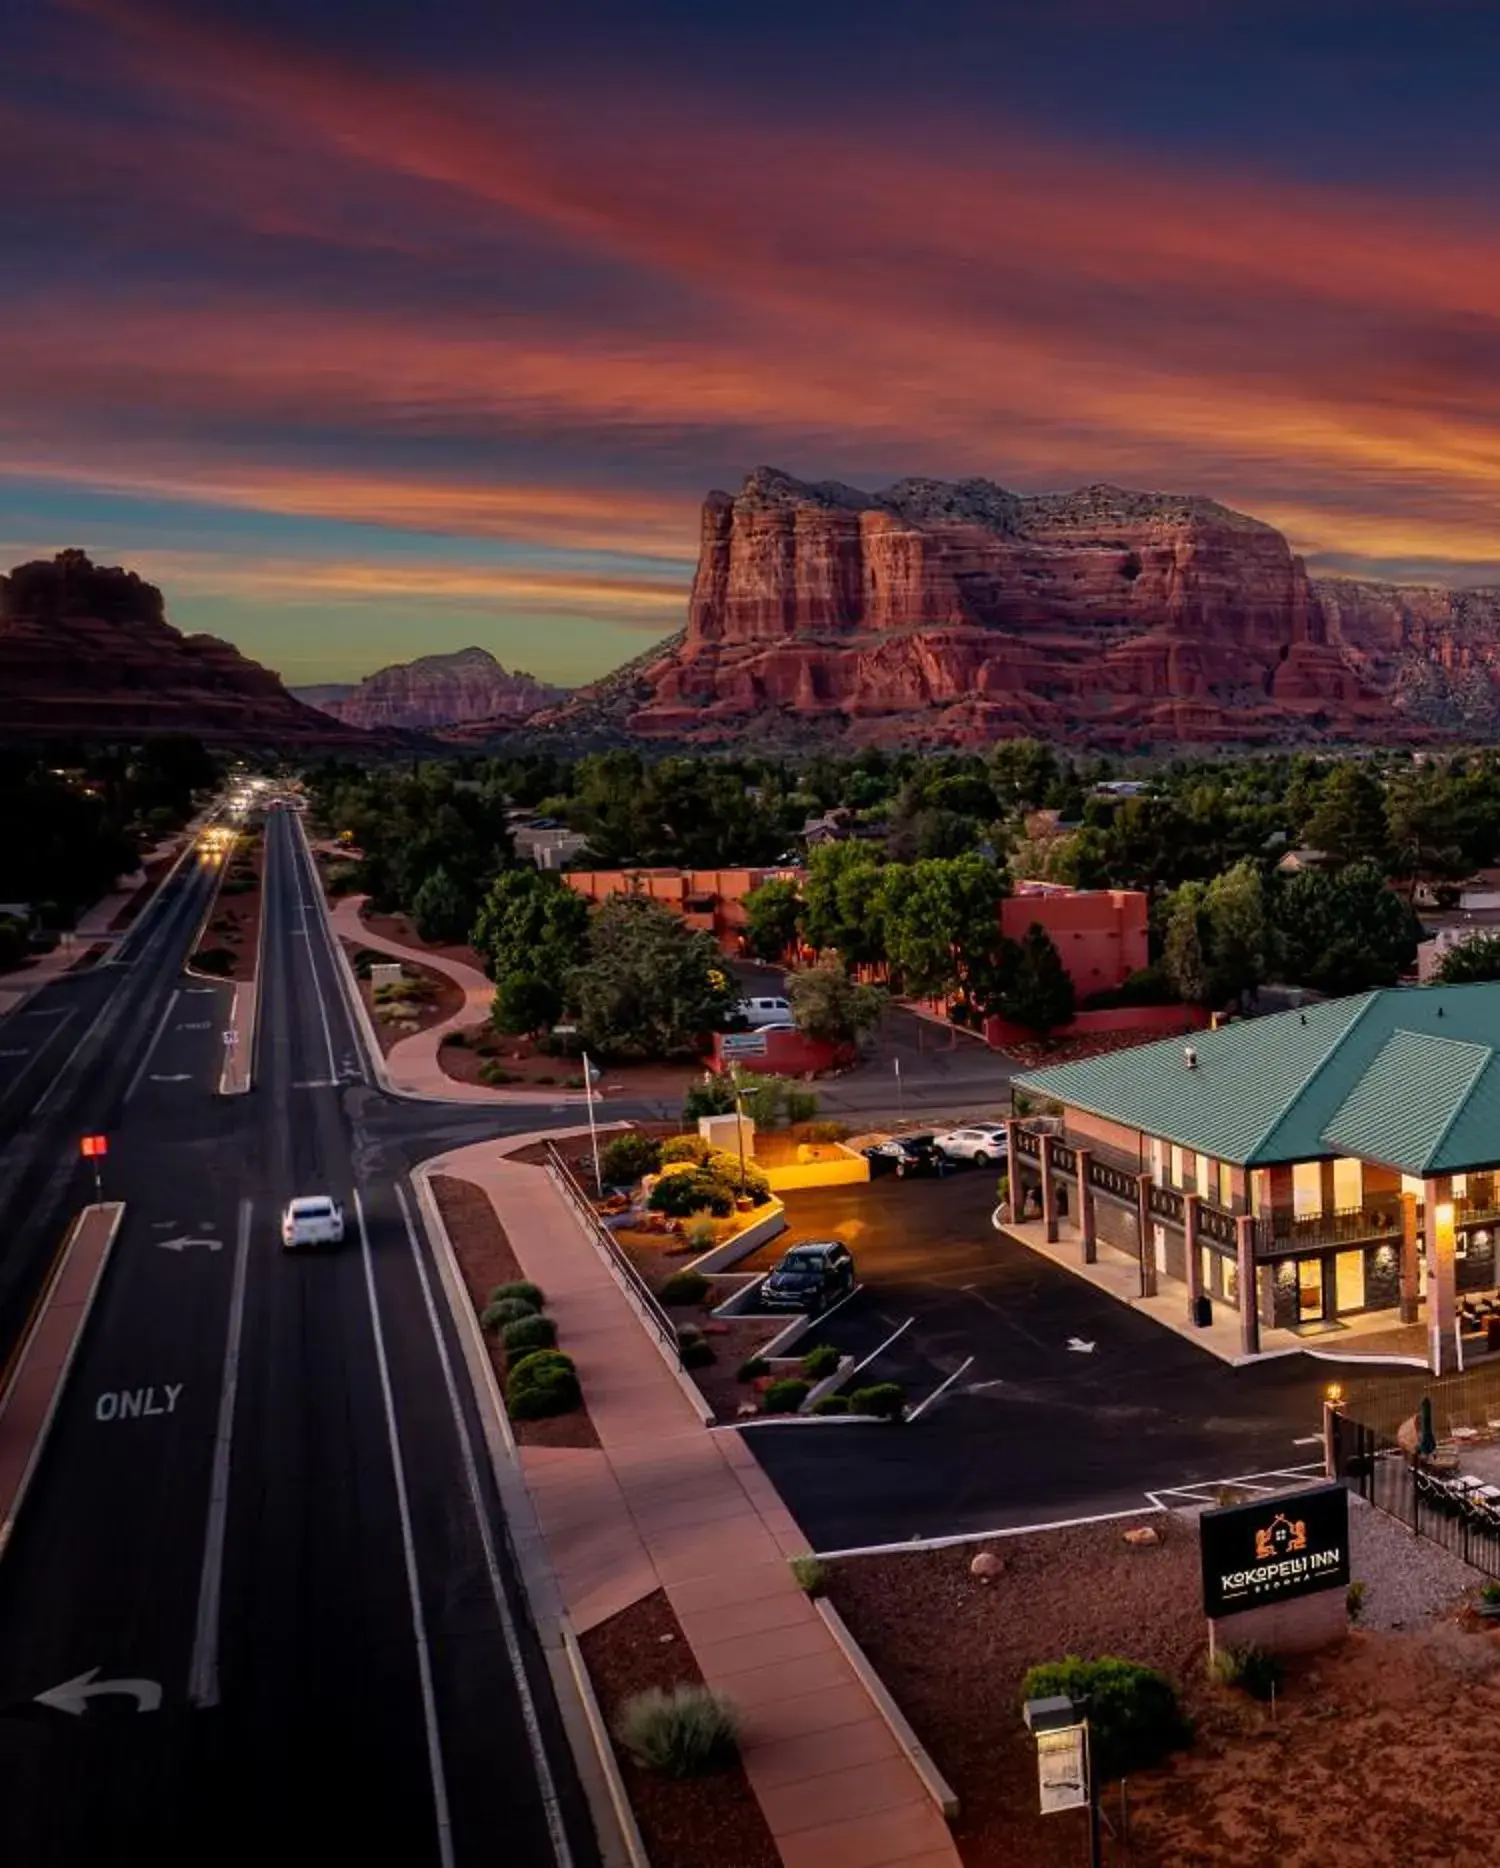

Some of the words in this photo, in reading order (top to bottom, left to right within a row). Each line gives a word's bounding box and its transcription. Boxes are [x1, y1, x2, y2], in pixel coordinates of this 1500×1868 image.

[95, 1383, 184, 1421] ONLY
[1221, 1557, 1307, 1591] KOKOPELLI
[1310, 1548, 1339, 1569] INN
